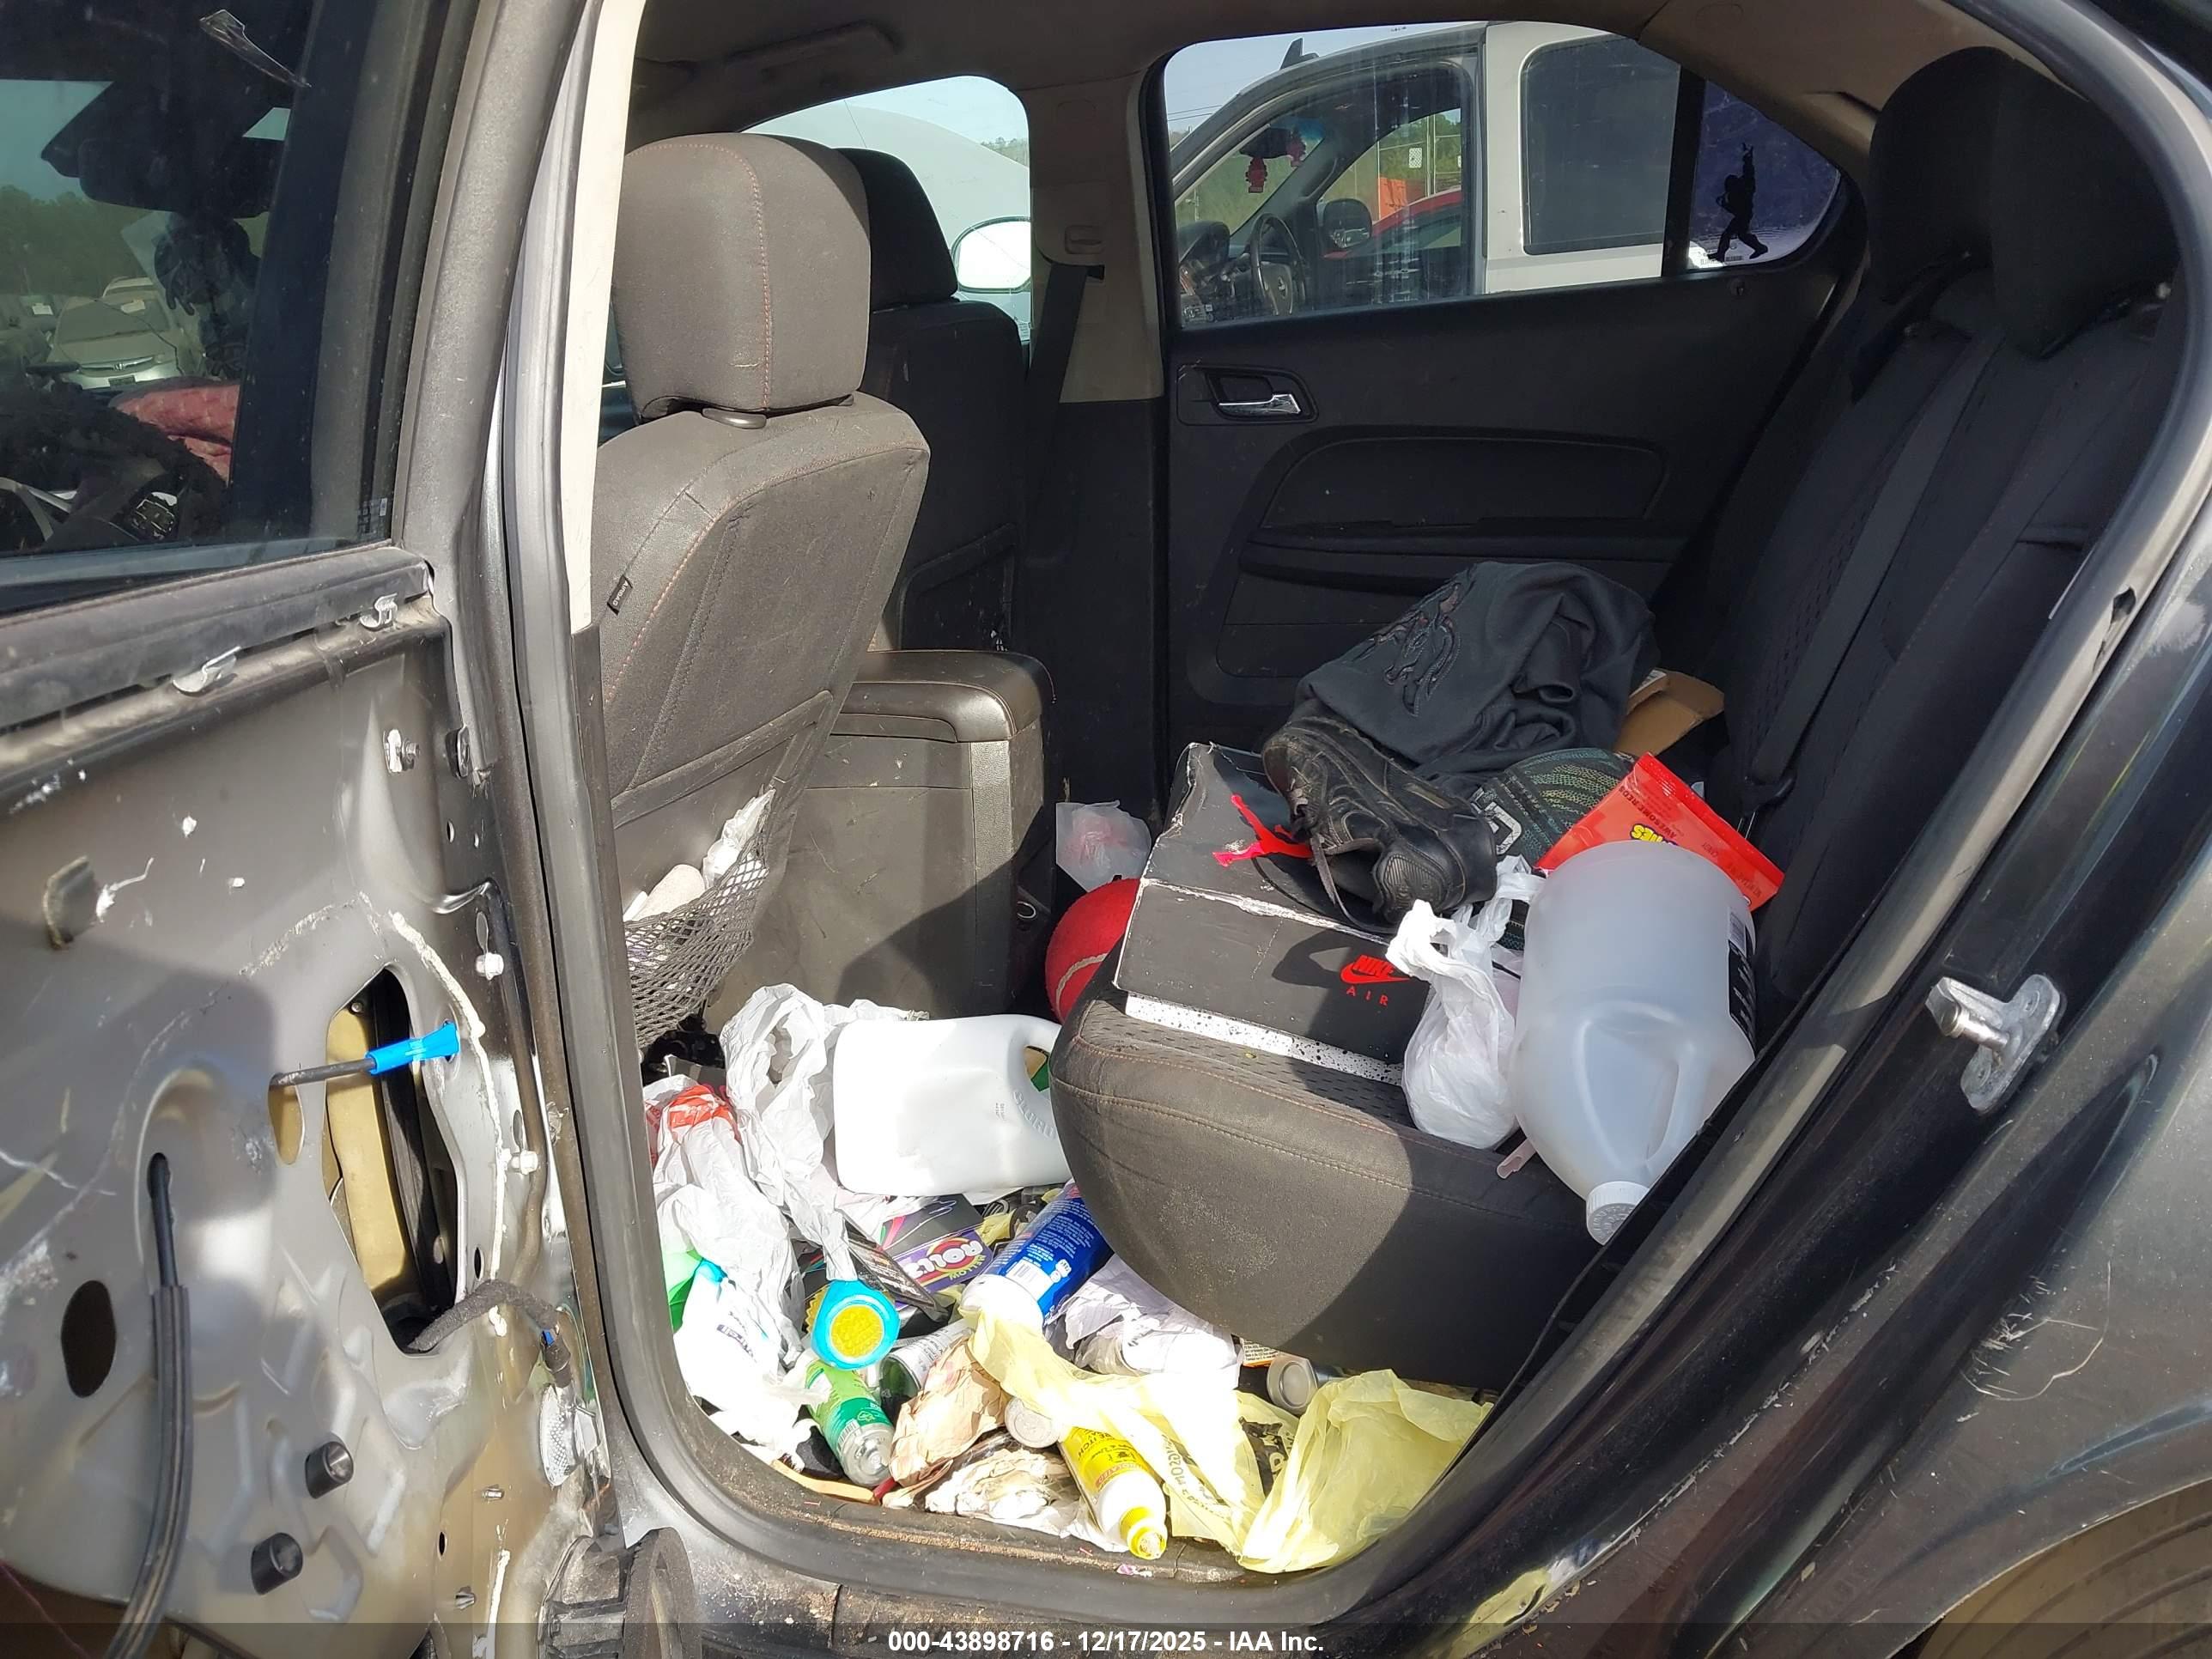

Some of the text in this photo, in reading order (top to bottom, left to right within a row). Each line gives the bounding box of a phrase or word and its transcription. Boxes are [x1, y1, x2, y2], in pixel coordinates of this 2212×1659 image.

[612, 580, 629, 606] AIRBAG
[1619, 785, 1639, 805] REDS
[1637, 804, 1677, 839] AWESOME
[1352, 954, 1395, 977] NIKE
[1346, 985, 1389, 1006] AIR
[947, 1254, 987, 1280] MELLOW
